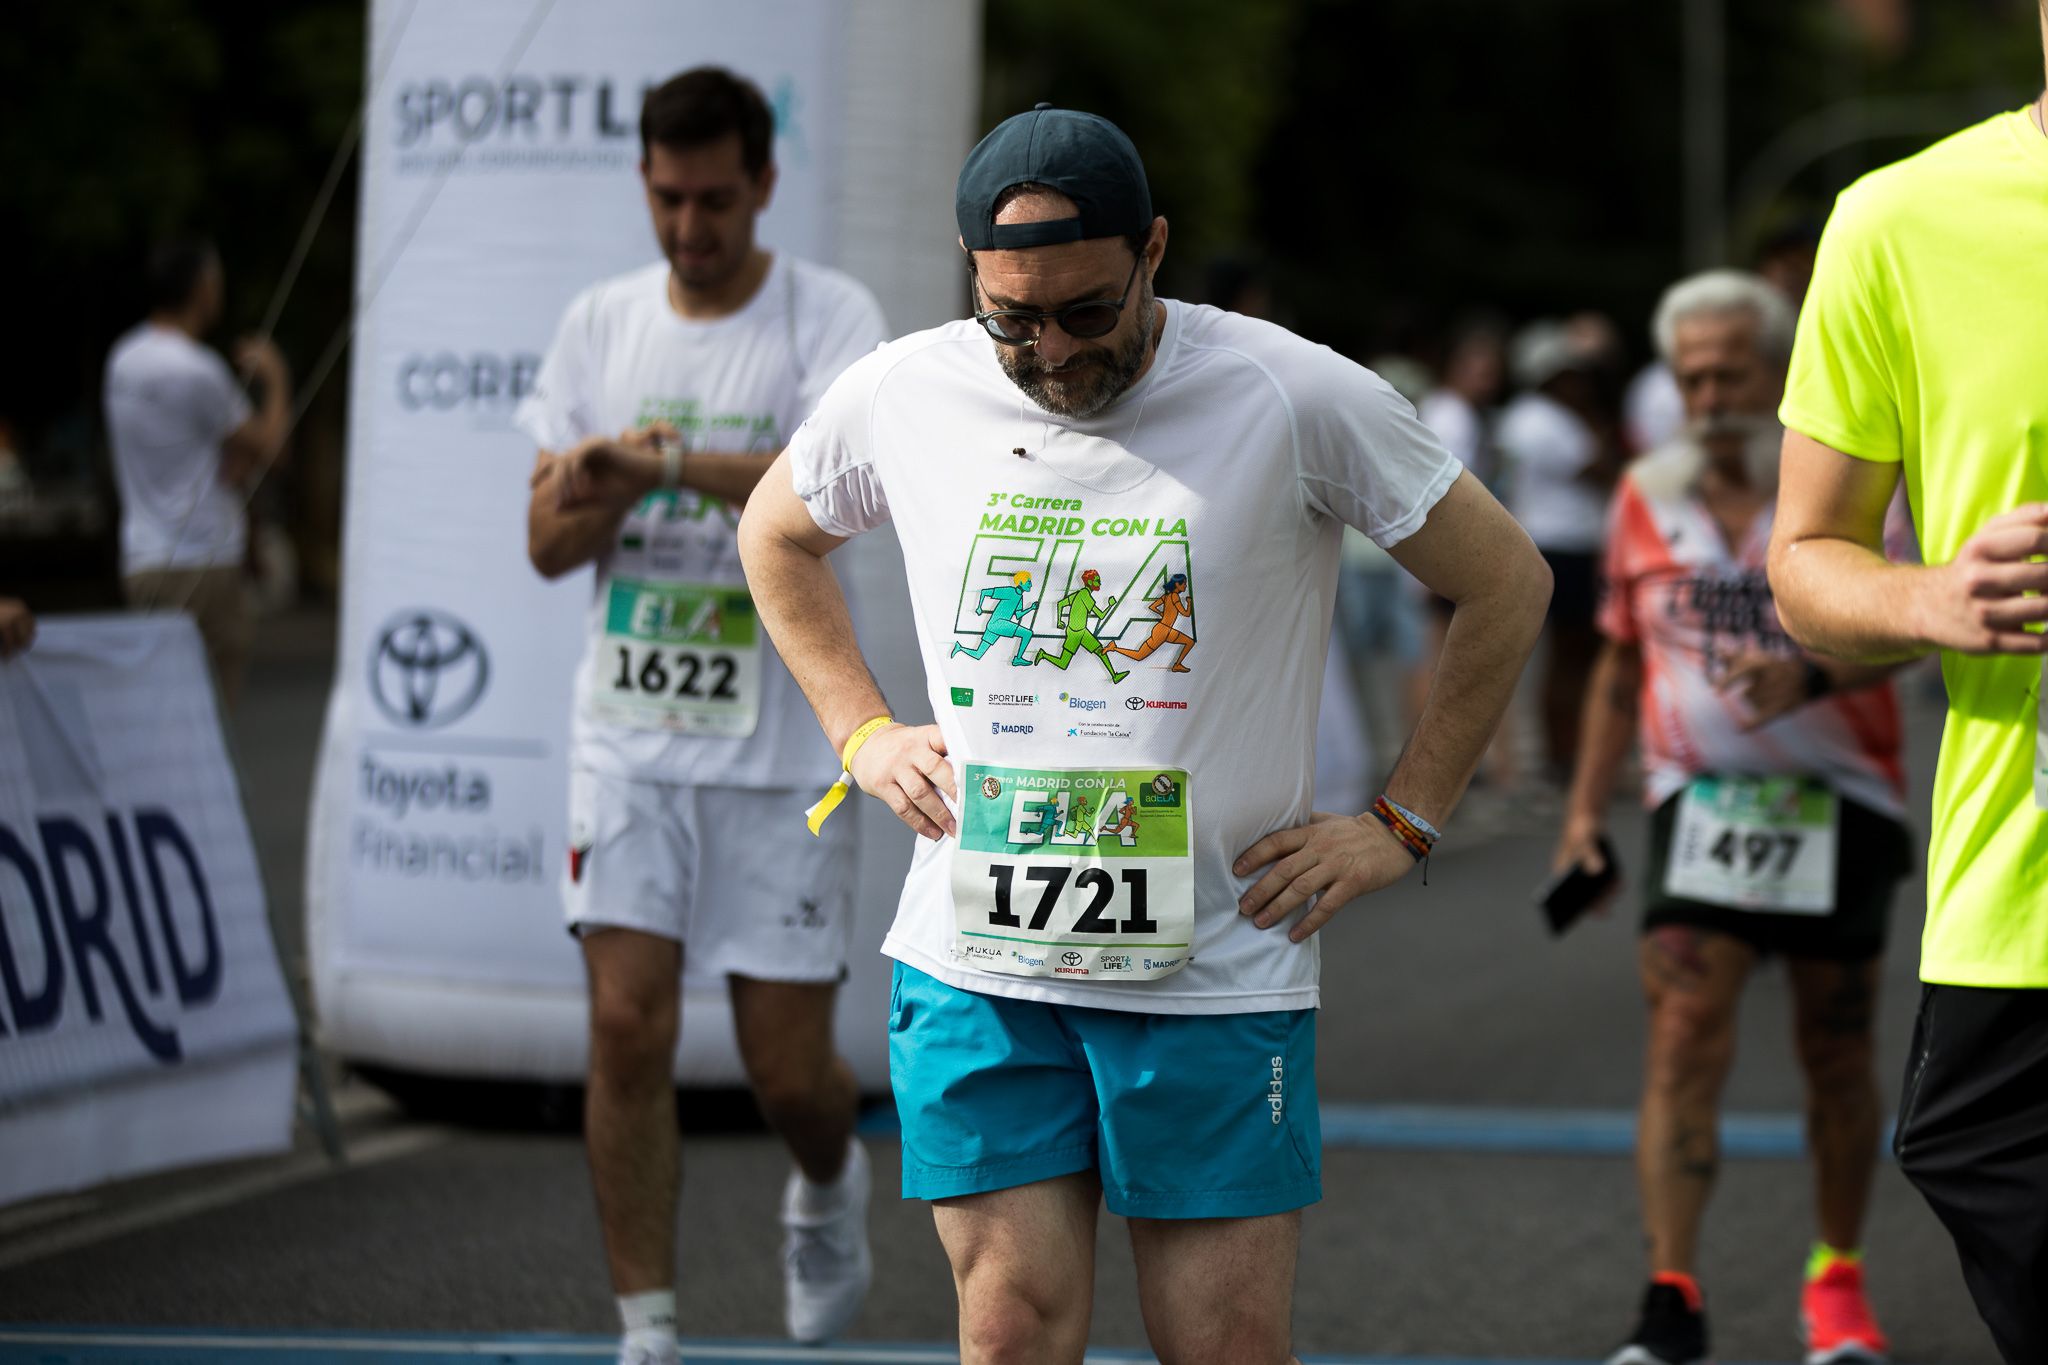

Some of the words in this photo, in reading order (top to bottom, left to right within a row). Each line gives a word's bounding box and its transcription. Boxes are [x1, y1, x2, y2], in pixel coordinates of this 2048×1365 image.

[979, 513, 1086, 536] MADRID
[1091, 518, 1150, 537] CON
[1153, 518, 1188, 537] LA
[1010, 493, 1083, 511] Carrera
[954, 534, 1198, 643] ELA
[631, 591, 721, 641] ELA
[614, 645, 739, 702] 1622
[1069, 698, 1107, 711] Biogen
[1001, 725, 1034, 735] MADRID
[361, 753, 490, 820] Toyota
[1016, 776, 1070, 790] MADRID
[1074, 778, 1105, 790] CON
[1109, 777, 1126, 790] LA
[1006, 790, 1137, 847] ELA
[353, 815, 546, 885] Financial
[1710, 828, 1804, 880] 497
[988, 864, 1158, 934] 1721
[0, 805, 223, 1064] DRID
[966, 946, 1002, 956] MUKUA
[1100, 955, 1125, 963] SPORT
[1018, 955, 1044, 967] Biogen
[1104, 962, 1122, 970] LIFE
[1268, 1056, 1283, 1125] adidas
